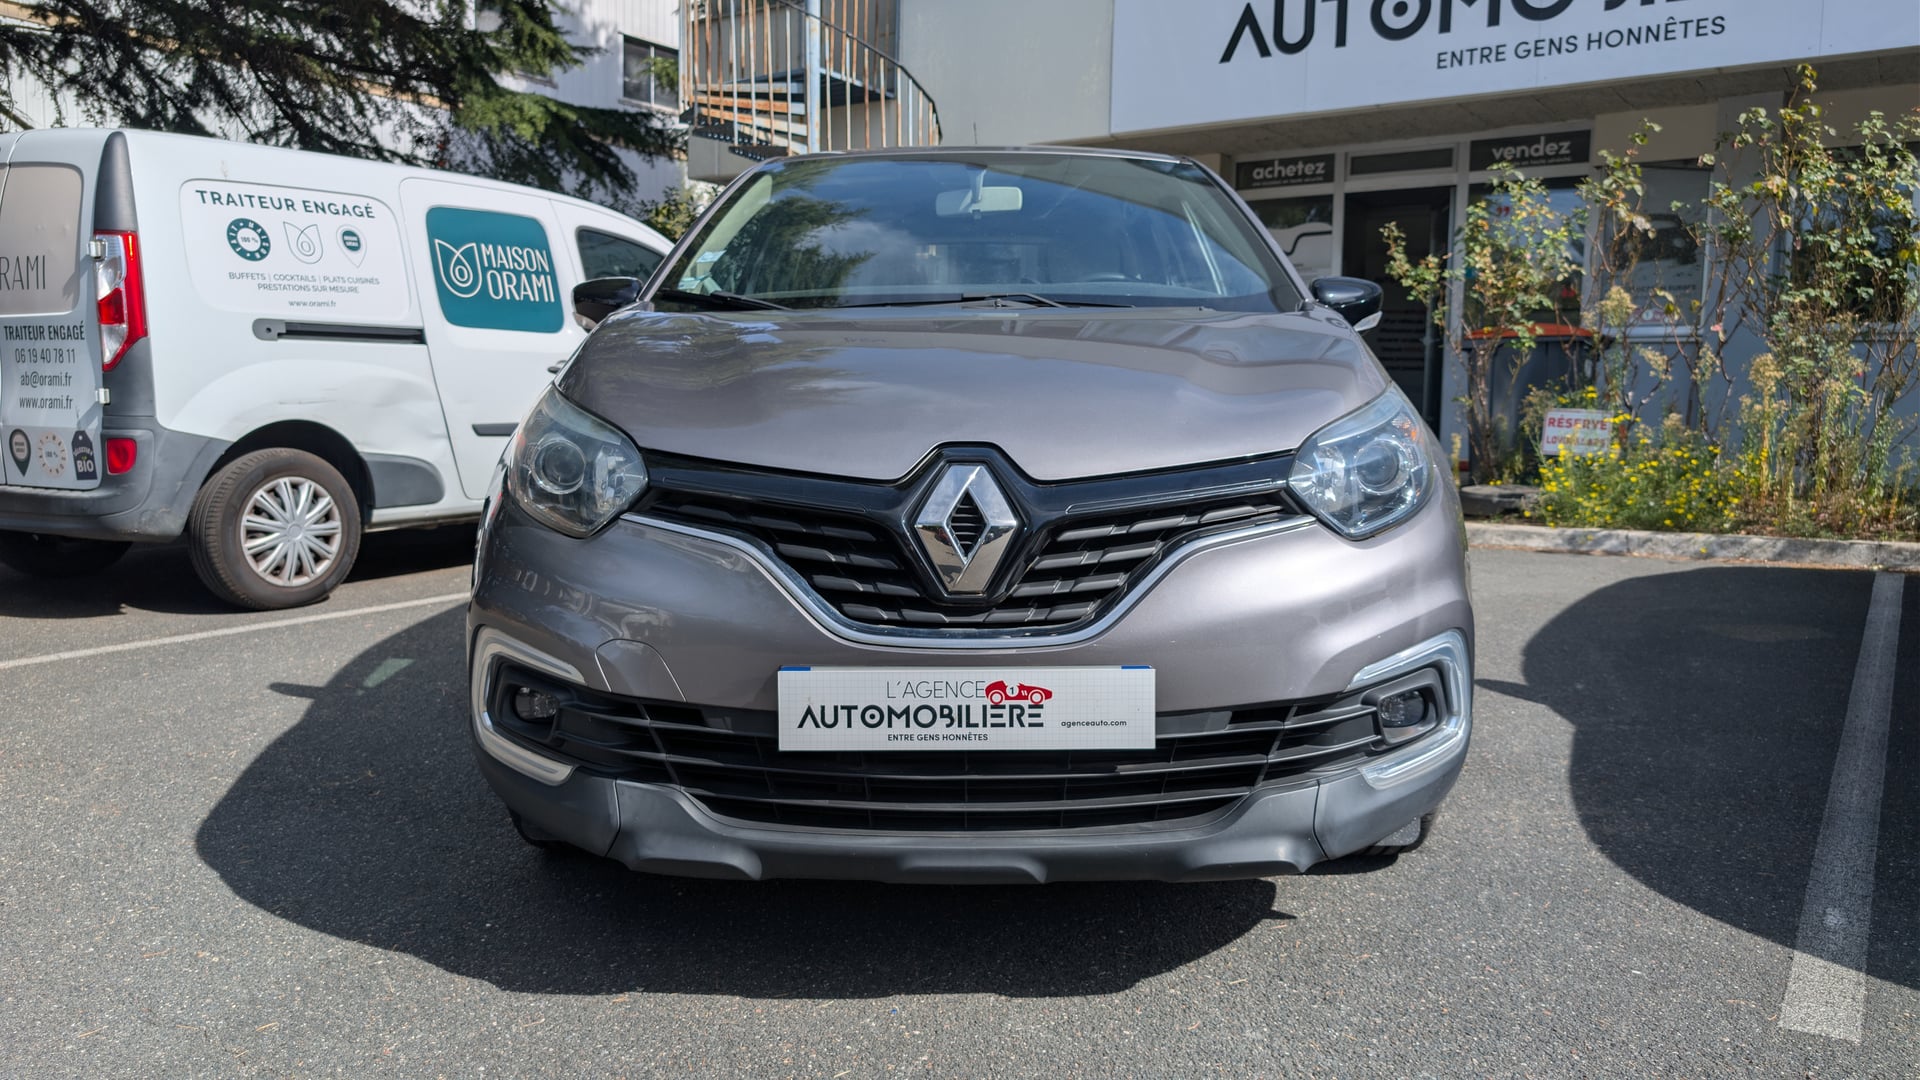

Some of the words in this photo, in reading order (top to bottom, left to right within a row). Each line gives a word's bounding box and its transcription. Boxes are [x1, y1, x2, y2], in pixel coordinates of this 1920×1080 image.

[1436, 43, 1507, 70] ENTRE
[1514, 35, 1577, 60] GENS
[1586, 16, 1726, 52] HONNÊTES
[1491, 136, 1571, 161] vendez
[1252, 159, 1326, 180] achetez
[195, 189, 297, 212] TRAITEUR
[302, 199, 376, 218] ENGAGÉ
[480, 243, 550, 273] MAISON
[228, 271, 266, 281] BUFFETS
[273, 273, 317, 283] COCKTAILS
[323, 276, 346, 284] PLATS
[347, 275, 380, 285] CUISINÉS
[487, 269, 555, 303] ORAMI
[257, 283, 311, 293] PRESTATIONS
[312, 284, 328, 293] SUR
[329, 285, 360, 294] MESURE
[288, 299, 337, 308] www.orami.fr
[4, 325, 45, 341] TRAITEUR
[48, 320, 85, 341] ENGAGÉ
[15, 348, 25, 364] 06
[28, 348, 38, 364] 19
[40, 348, 51, 364] 40
[53, 348, 64, 364] 78
[67, 348, 75, 363] 11
[20, 371, 72, 388] ab@orami.fr
[19, 395, 73, 410] www.orami.fr
[76, 459, 94, 473] BIO
[1060, 718, 1127, 728] agenceauto.com
[887, 734, 915, 742] ENTRE
[916, 733, 941, 742] GENS
[942, 731, 989, 742] HONNÊTES
